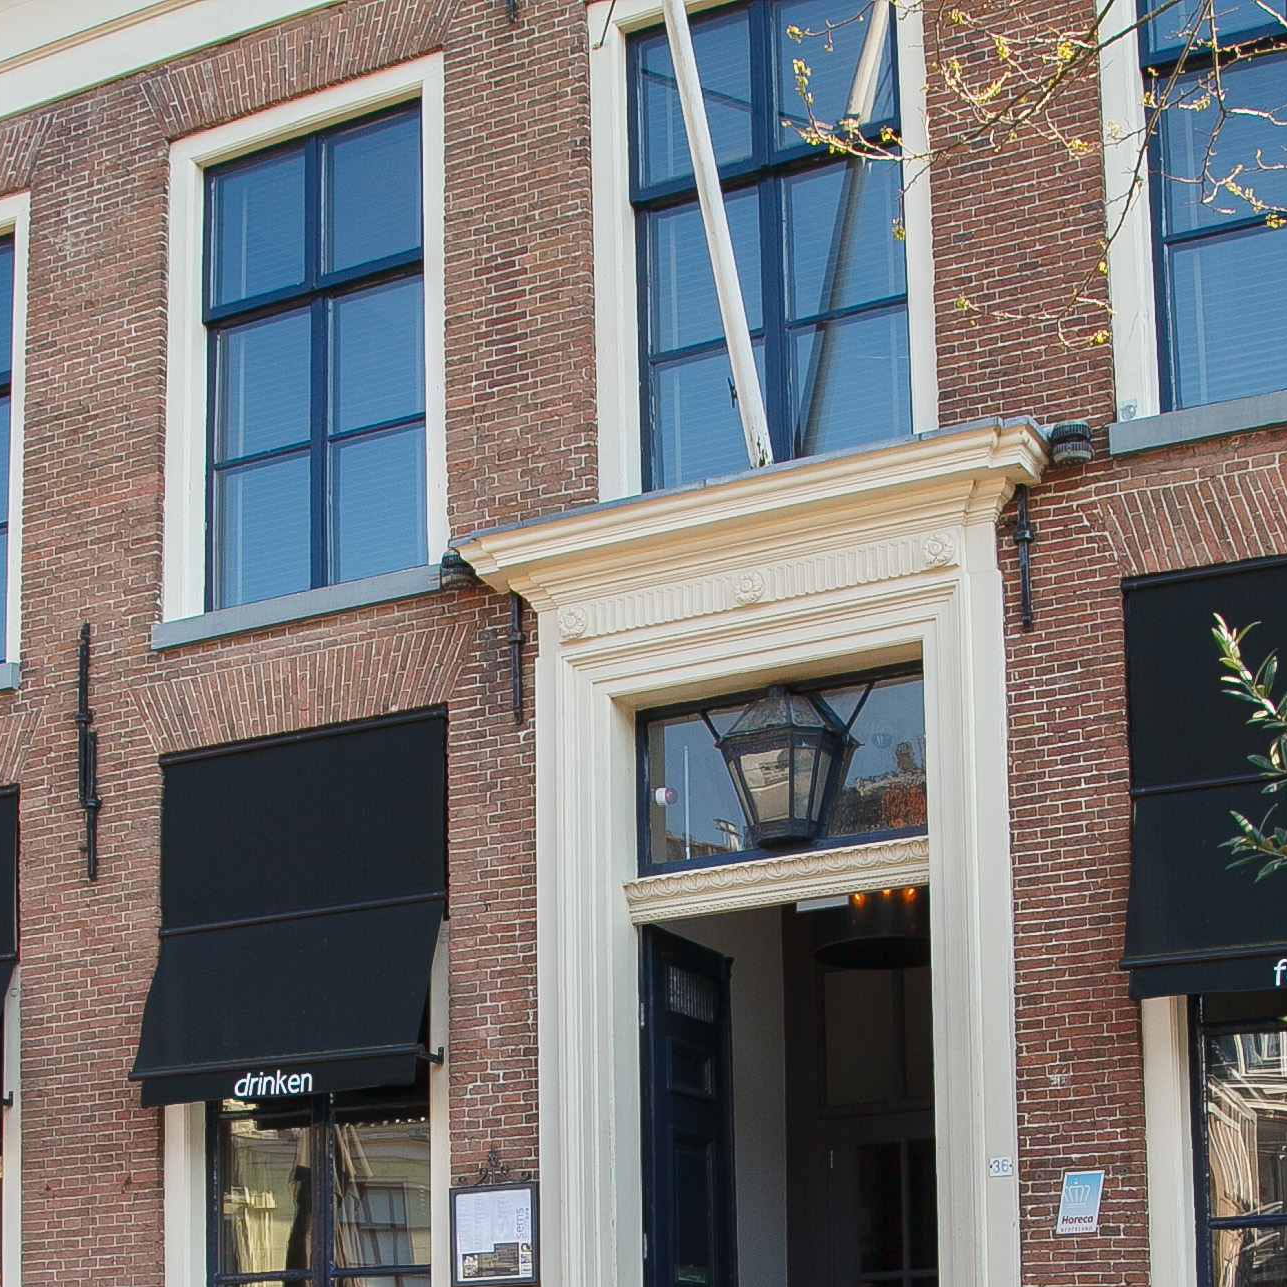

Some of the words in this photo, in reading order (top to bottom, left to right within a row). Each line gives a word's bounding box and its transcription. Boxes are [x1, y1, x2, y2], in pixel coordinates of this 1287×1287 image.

[234, 1070, 313, 1097] drinken
[993, 1159, 1009, 1173] 36
[1061, 1215, 1094, 1224] Horeca
